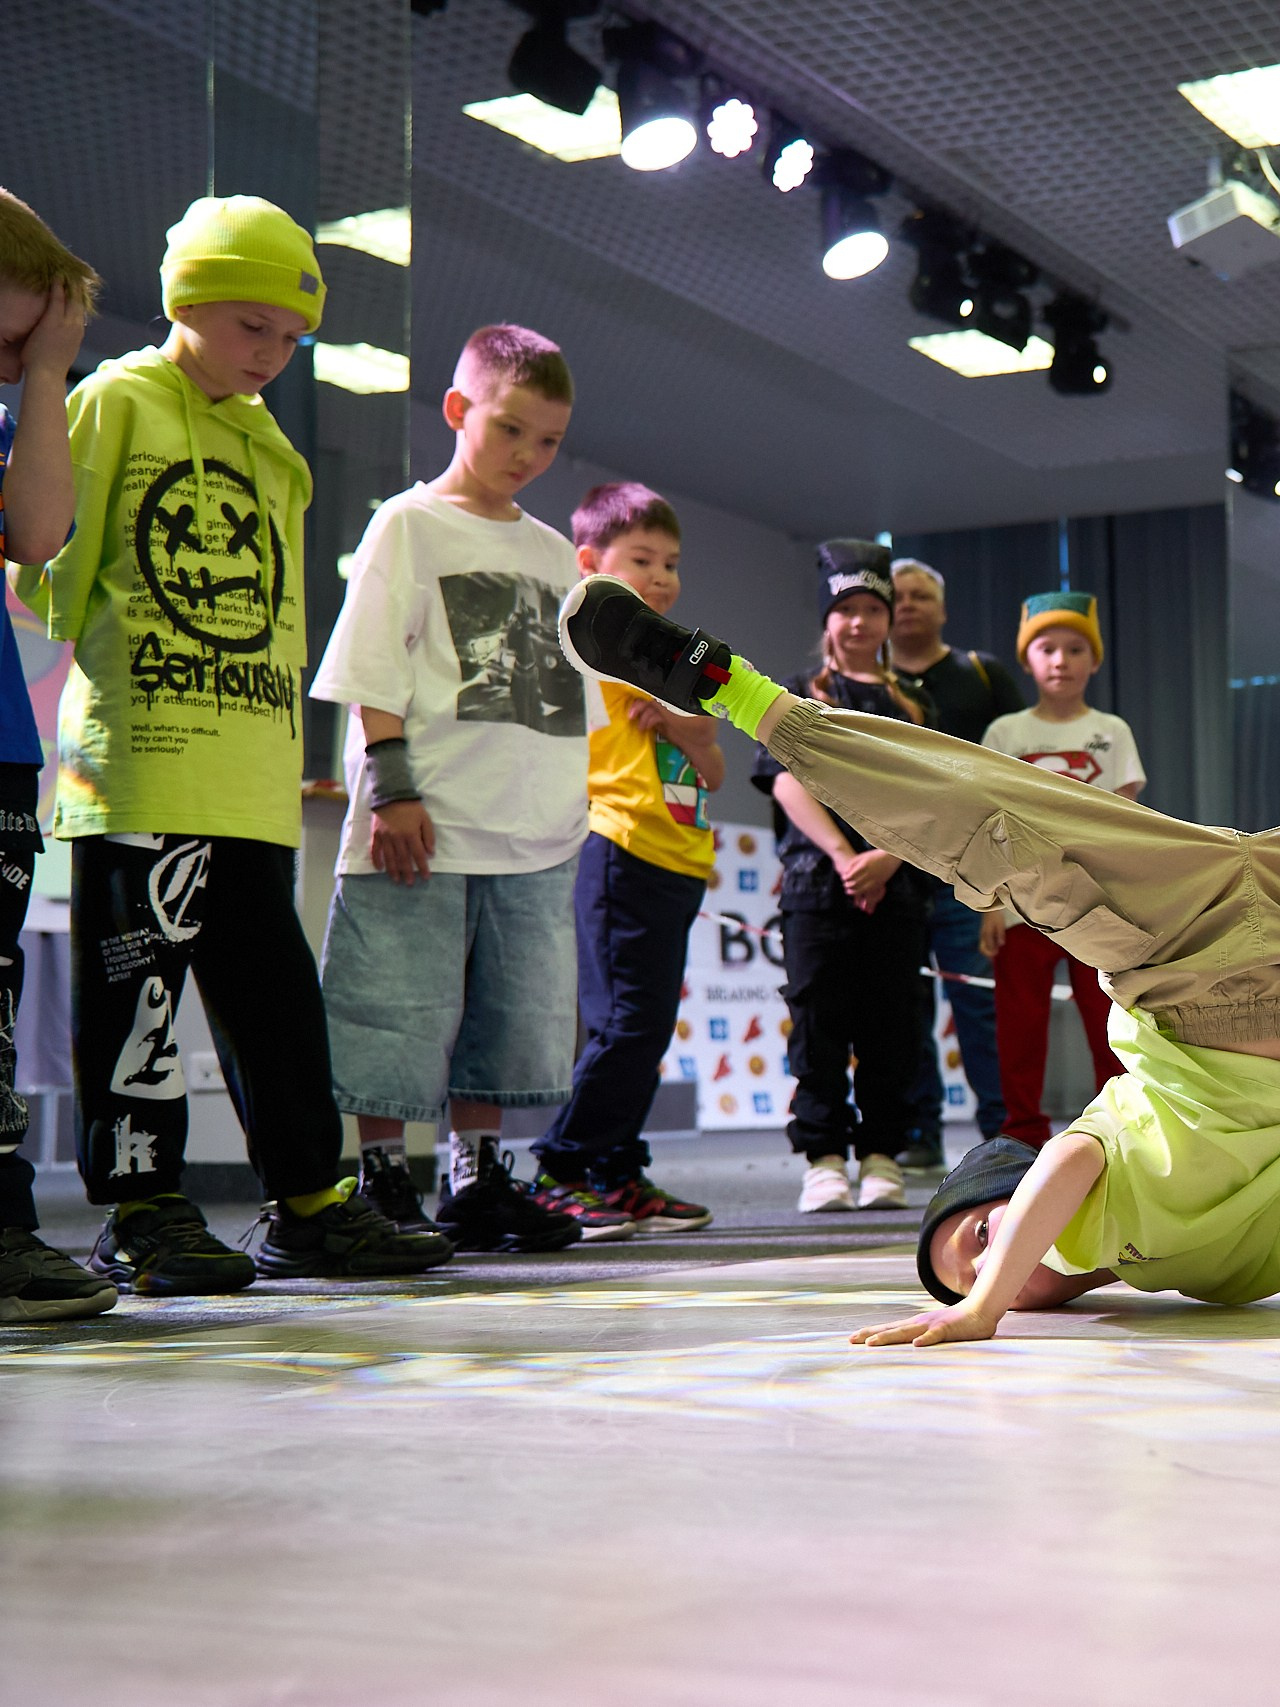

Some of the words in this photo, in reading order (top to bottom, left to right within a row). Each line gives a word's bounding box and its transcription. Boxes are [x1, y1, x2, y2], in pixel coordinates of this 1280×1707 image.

[203, 602, 242, 614] rmarks
[127, 606, 138, 617] is
[207, 615, 218, 624] or
[164, 695, 215, 708] attention
[240, 702, 271, 718] respect
[131, 723, 152, 733] Well,
[154, 724, 180, 734] what's
[131, 735, 152, 744] Why
[153, 735, 173, 744] can't
[131, 745, 143, 754] be
[145, 746, 184, 756] seriously?
